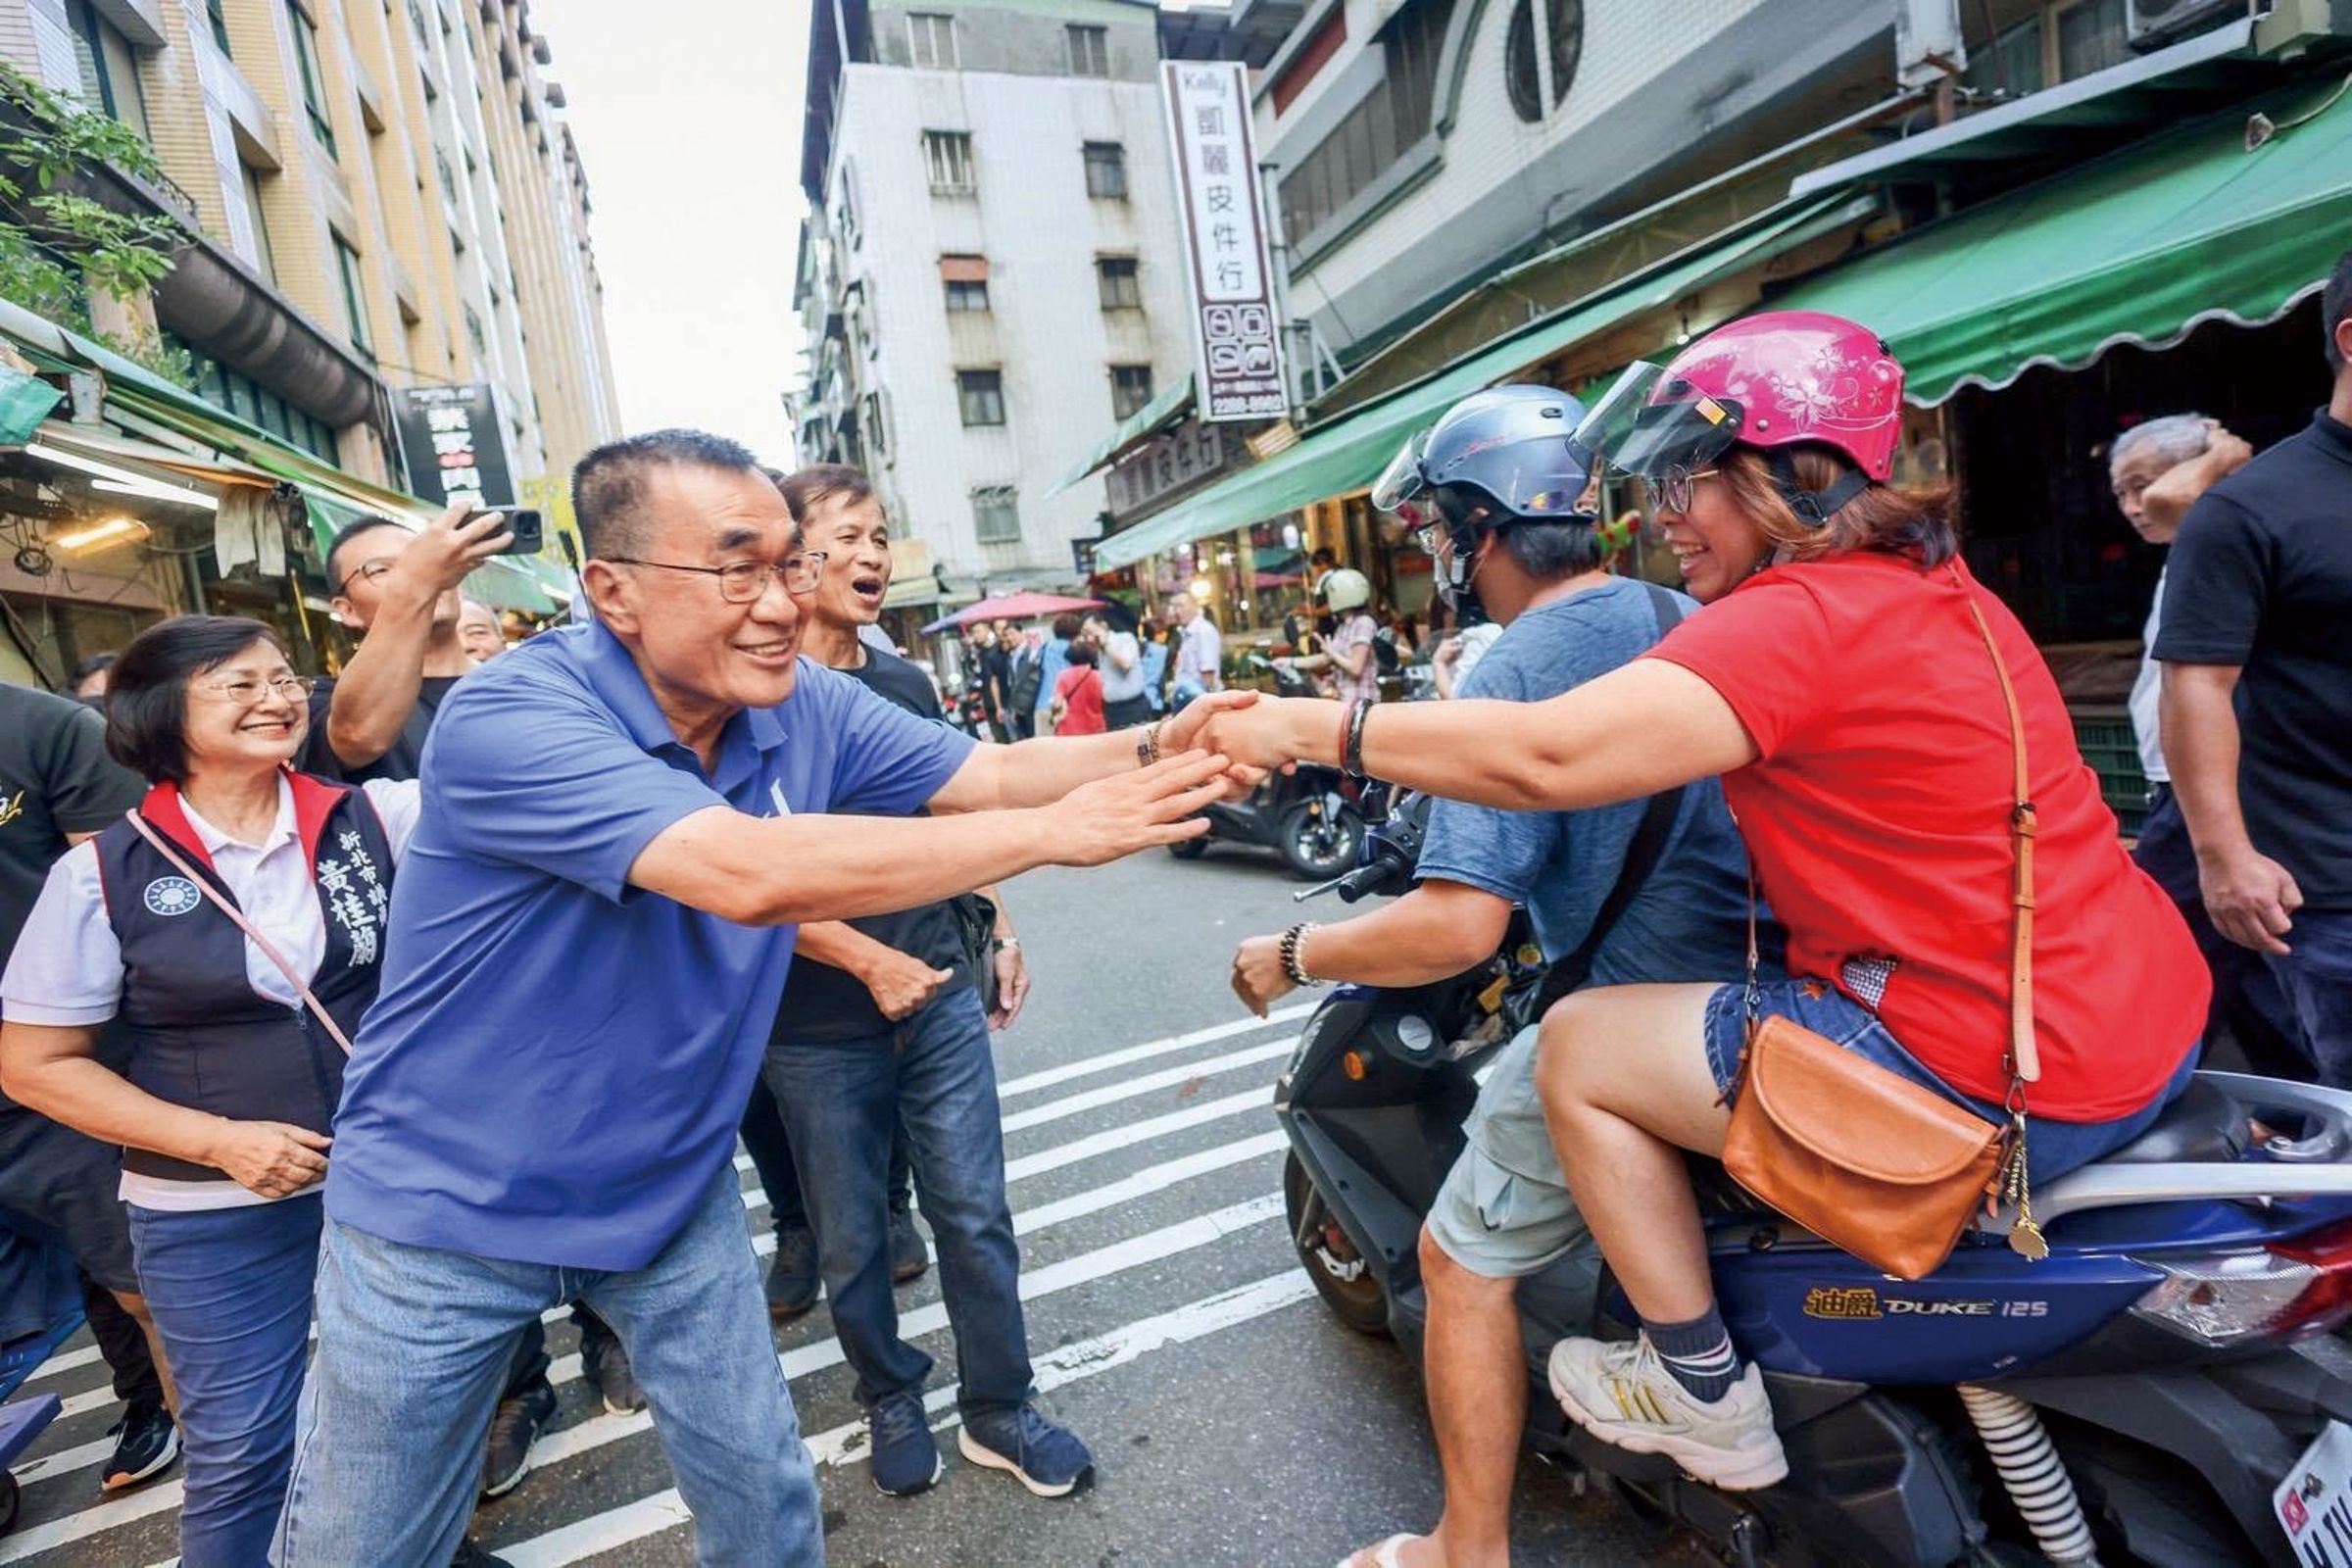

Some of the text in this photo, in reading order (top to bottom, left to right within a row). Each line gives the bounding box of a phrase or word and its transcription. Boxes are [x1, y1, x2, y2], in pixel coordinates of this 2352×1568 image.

[1802, 1287, 2048, 1319] 迪爵 DUKE 125
